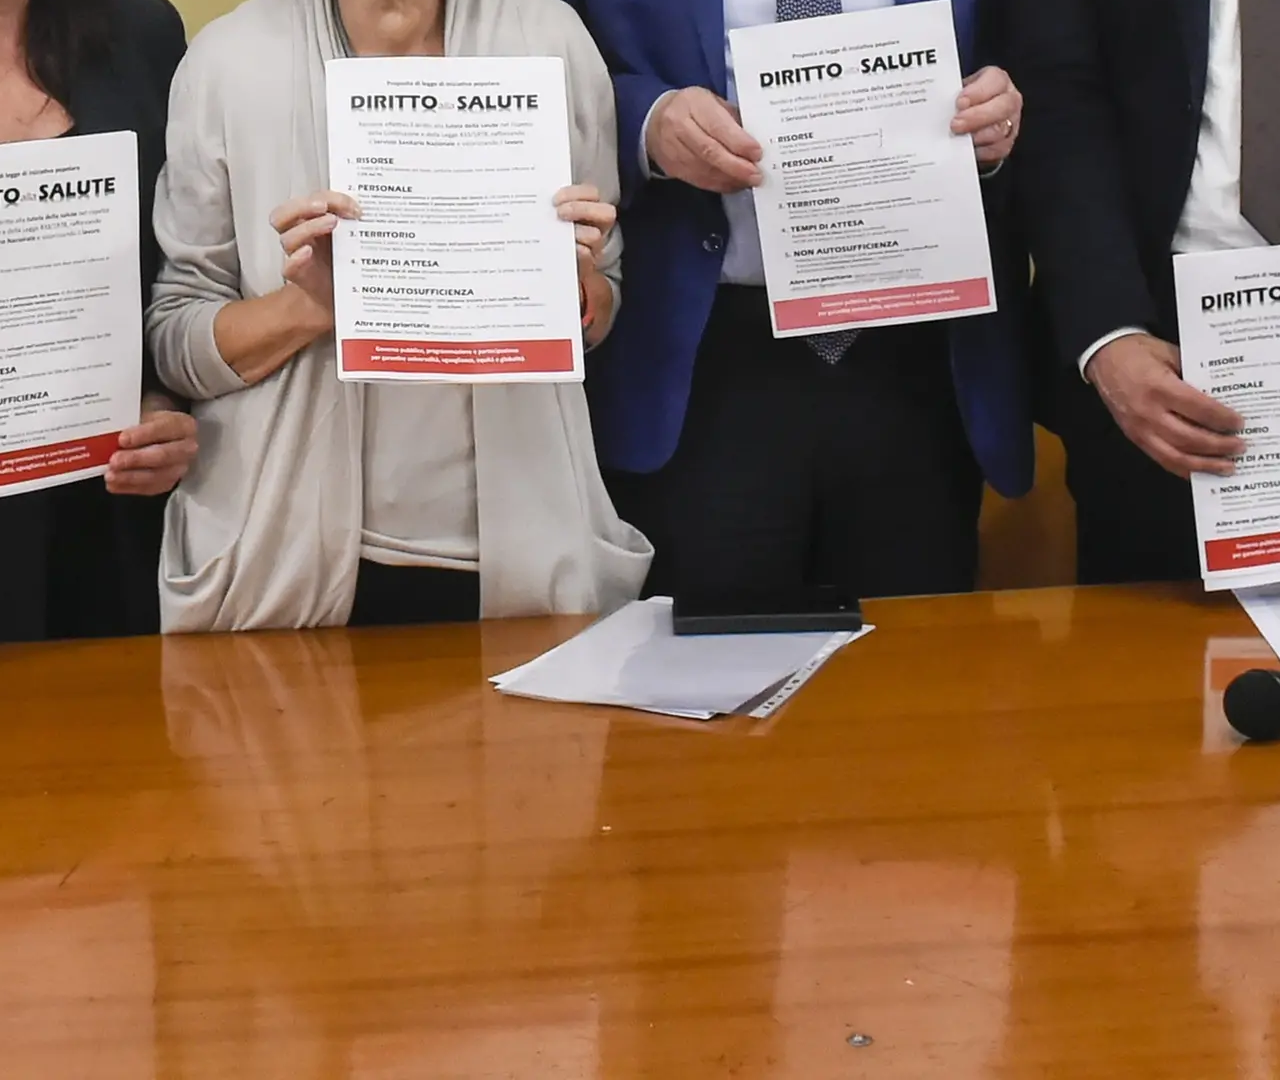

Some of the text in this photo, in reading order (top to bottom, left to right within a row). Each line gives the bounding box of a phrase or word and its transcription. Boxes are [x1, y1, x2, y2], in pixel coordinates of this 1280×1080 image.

[760, 49, 937, 89] DIRITTO SALUTE
[351, 95, 438, 109] DIRITTO
[457, 94, 538, 108] SALUTE
[778, 131, 814, 142] RISORSE
[781, 155, 834, 169] PERSONALE
[39, 177, 116, 202] SALUTE
[358, 185, 413, 193] PERSONALE
[787, 196, 840, 208] TERRITORIO
[790, 222, 817, 233] TEMPI
[819, 221, 828, 230] DI
[831, 218, 864, 229] ATTESA
[359, 231, 416, 239] TERRITORIO
[793, 247, 814, 257] NON
[816, 239, 899, 255] AUTOSUFFICIENZA
[361, 258, 389, 266] TEMPI
[403, 259, 439, 267] ATTESA
[362, 286, 384, 294] NON
[386, 287, 474, 296] AUTOSUFFICIENZA
[393, 321, 430, 329] prioritarie
[1208, 355, 1245, 367] RISORSE
[1211, 380, 1264, 393] PERSONALE
[1247, 452, 1257, 462] DI
[1220, 484, 1242, 494] NON
